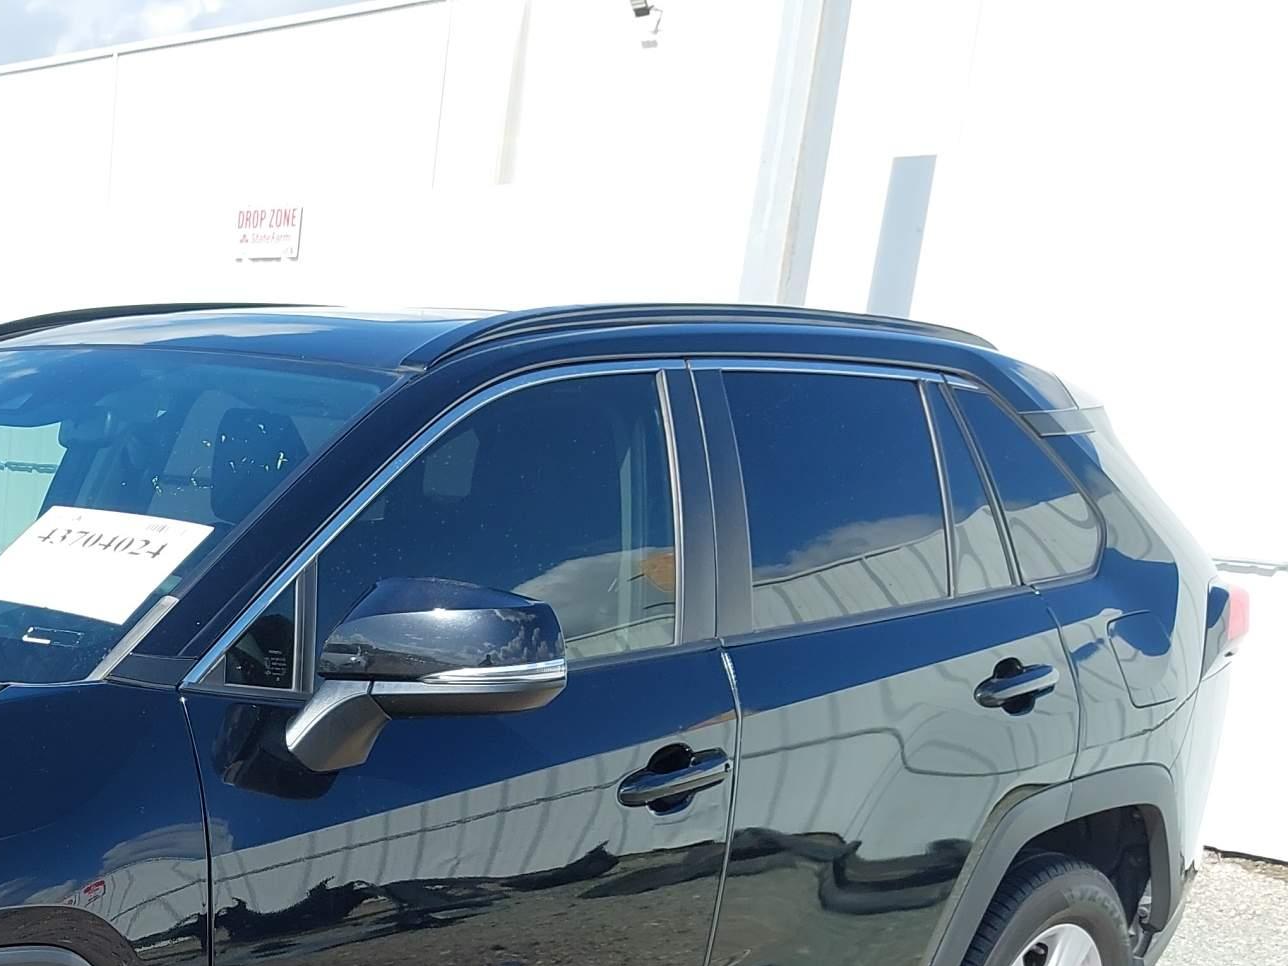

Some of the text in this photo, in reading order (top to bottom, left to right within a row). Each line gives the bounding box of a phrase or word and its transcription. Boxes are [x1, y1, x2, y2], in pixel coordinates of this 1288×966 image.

[238, 208, 297, 229] DROP ZONE
[37, 527, 168, 559] 43704024
